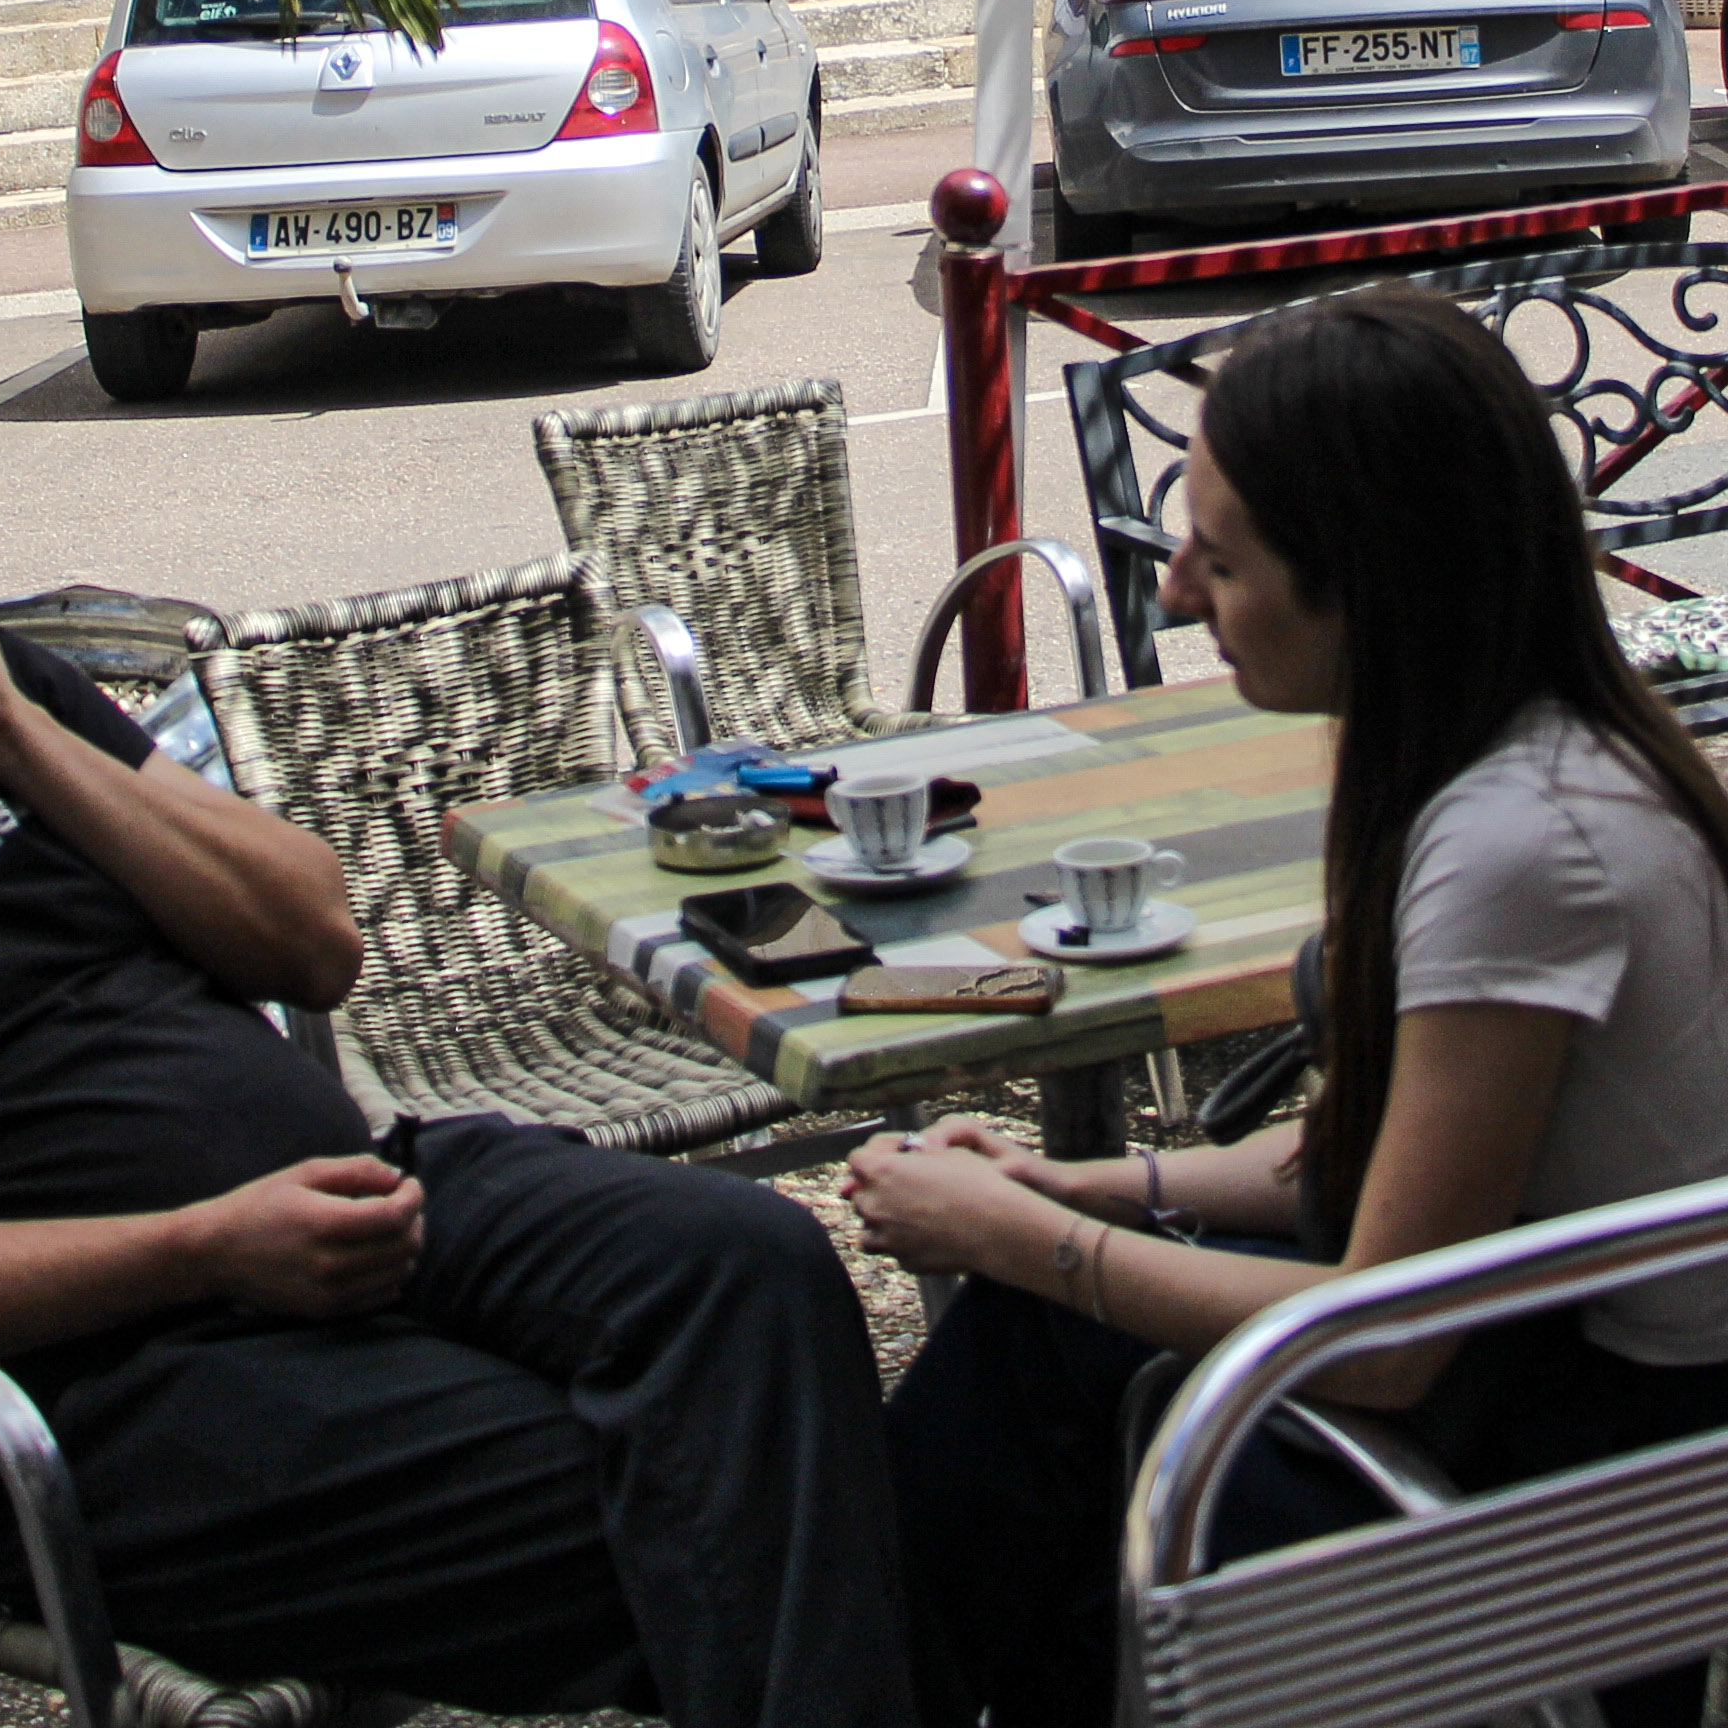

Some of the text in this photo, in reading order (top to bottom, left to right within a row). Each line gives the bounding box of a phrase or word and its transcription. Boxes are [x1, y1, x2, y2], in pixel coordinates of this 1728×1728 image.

[1166, 3, 1227, 21] HYUNDAI
[1302, 29, 1457, 66] FF-255-NT
[1460, 46, 1480, 63] 87
[274, 207, 434, 249] AW-490-BZ
[437, 223, 455, 240] 09
